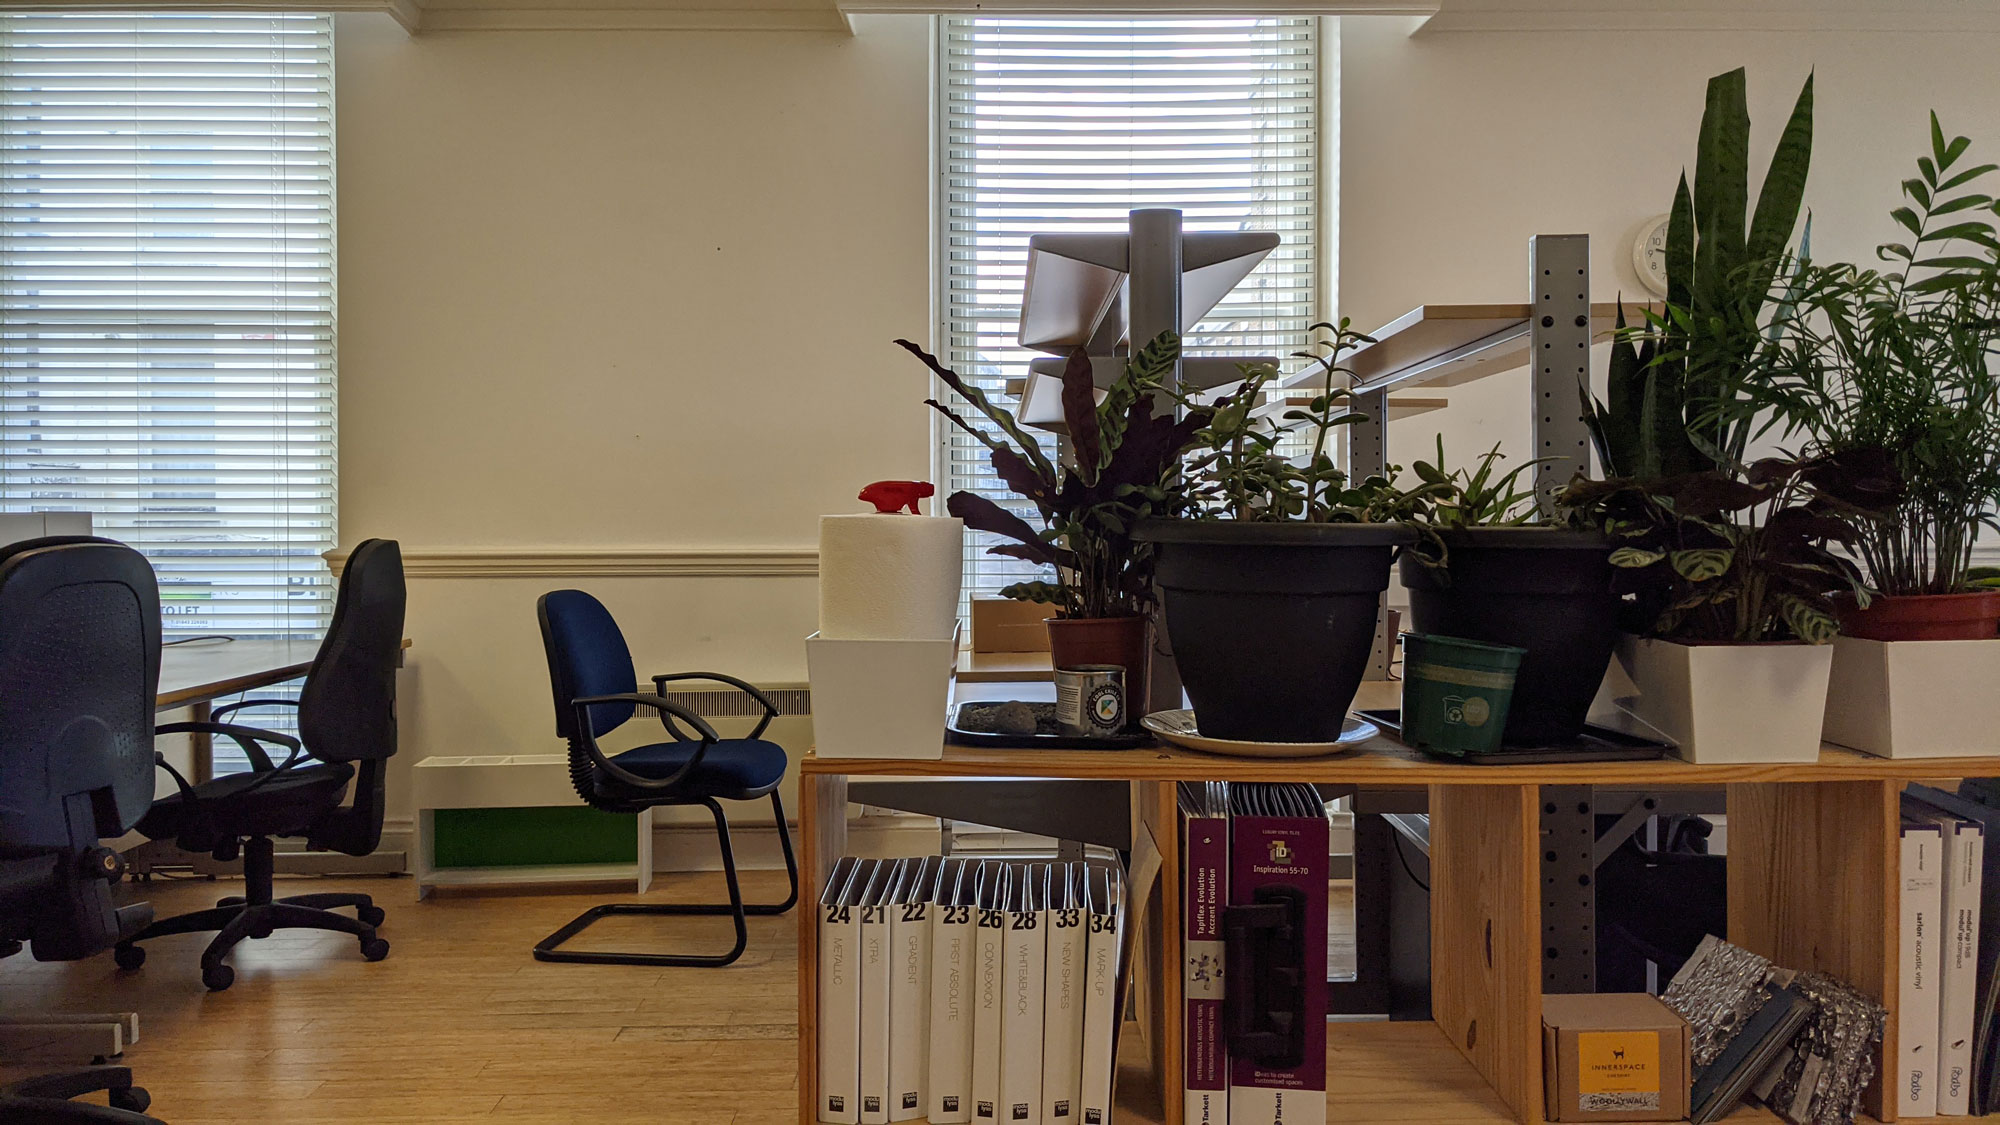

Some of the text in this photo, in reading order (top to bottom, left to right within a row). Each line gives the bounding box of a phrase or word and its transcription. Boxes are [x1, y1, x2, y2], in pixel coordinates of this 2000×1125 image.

[1652, 237, 1661, 246] 10
[1647, 249, 1653, 258] 9
[1651, 262, 1657, 270] 8
[1253, 865, 1309, 875] Inspiration 55-70
[1197, 867, 1206, 935] Tapiflex Evolution
[1208, 868, 1216, 935] Acczent Evolution
[826, 904, 850, 924] 24
[862, 905, 885, 924] 21
[901, 902, 926, 922] 22
[943, 906, 970, 924] 23
[978, 909, 1002, 929] 26
[1011, 911, 1036, 930] 28
[1055, 909, 1080, 928] 33
[1091, 914, 1116, 934] 34
[869, 937, 879, 964] XTRA
[908, 935, 918, 985] GRADIENT
[1915, 940, 1923, 970] acoustic
[833, 937, 843, 985] METALLIC
[949, 938, 961, 1021] FIRST ABSOLUTE
[1017, 943, 1028, 1017] WHITE&BLACK
[1060, 942, 1071, 1010] NEW SHAPES
[1913, 972, 1923, 990] vinyl
[1591, 1063, 1645, 1071] INNERSPACE
